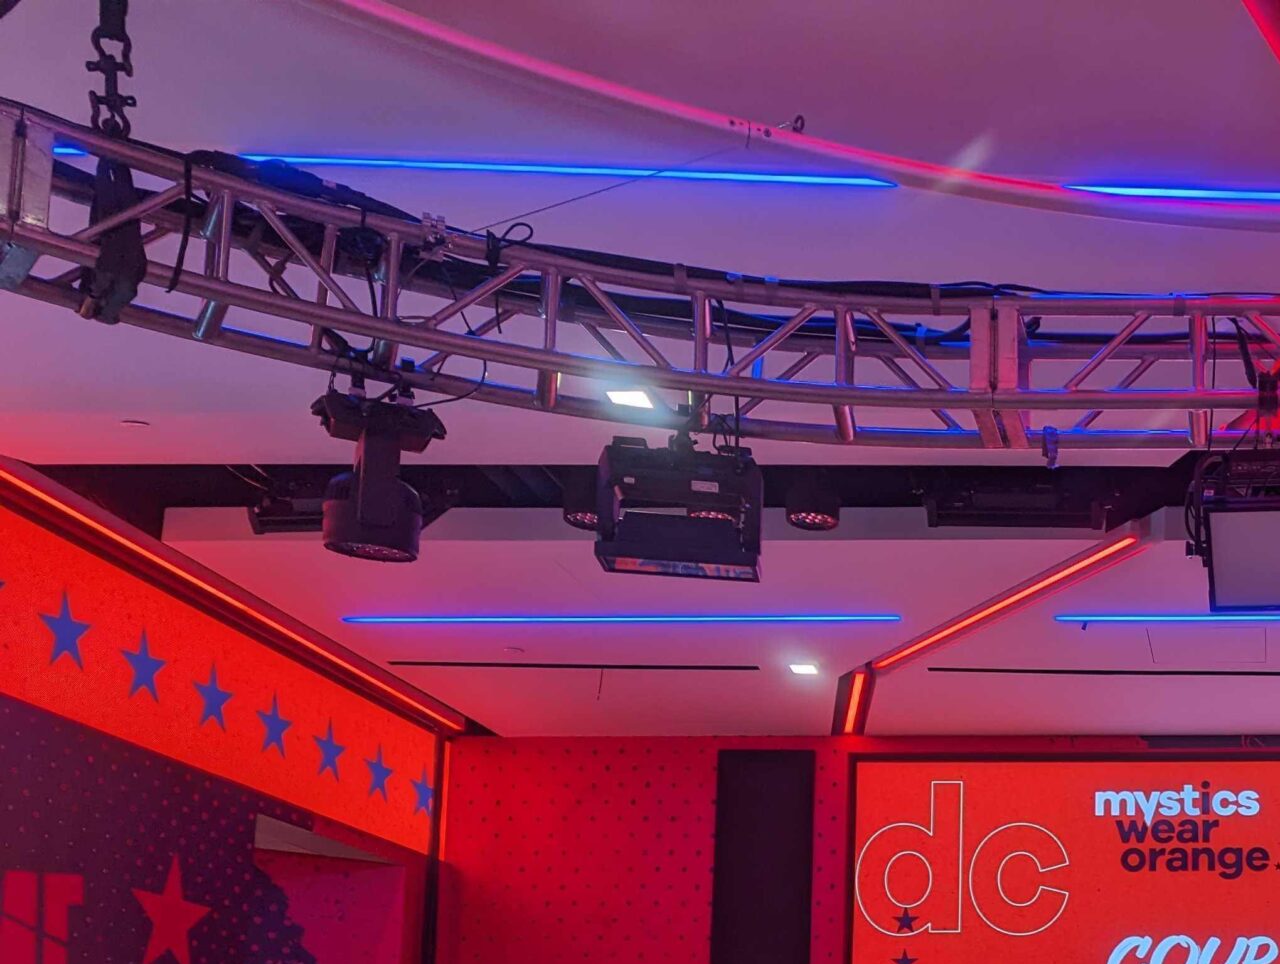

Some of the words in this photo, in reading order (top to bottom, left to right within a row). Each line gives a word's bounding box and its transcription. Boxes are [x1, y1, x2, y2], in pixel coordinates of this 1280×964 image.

[1095, 780, 1260, 826] mystics
[1115, 819, 1220, 844] wear
[855, 780, 1070, 936] dc
